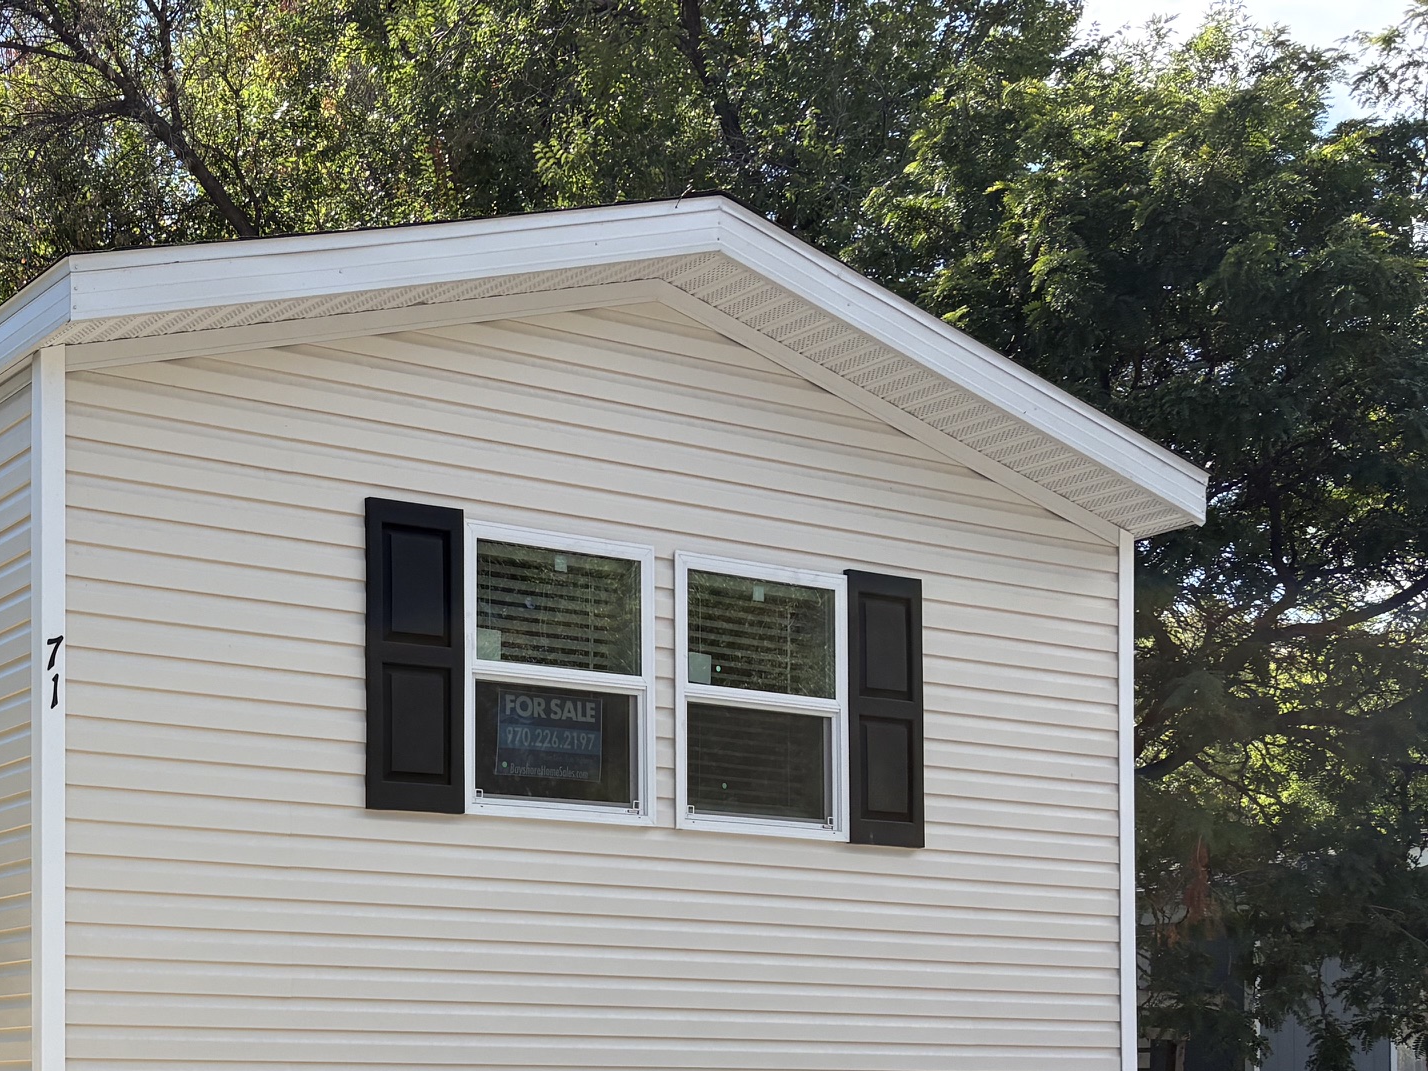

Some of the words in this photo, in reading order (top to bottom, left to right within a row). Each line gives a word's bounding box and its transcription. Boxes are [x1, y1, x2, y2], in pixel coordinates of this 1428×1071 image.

[47, 635, 64, 709] 71
[505, 694, 547, 718] FOR
[550, 699, 596, 723] SALE
[506, 726, 595, 750] 970.226.2197
[509, 762, 589, 779] BayshoreHomeSales.com
